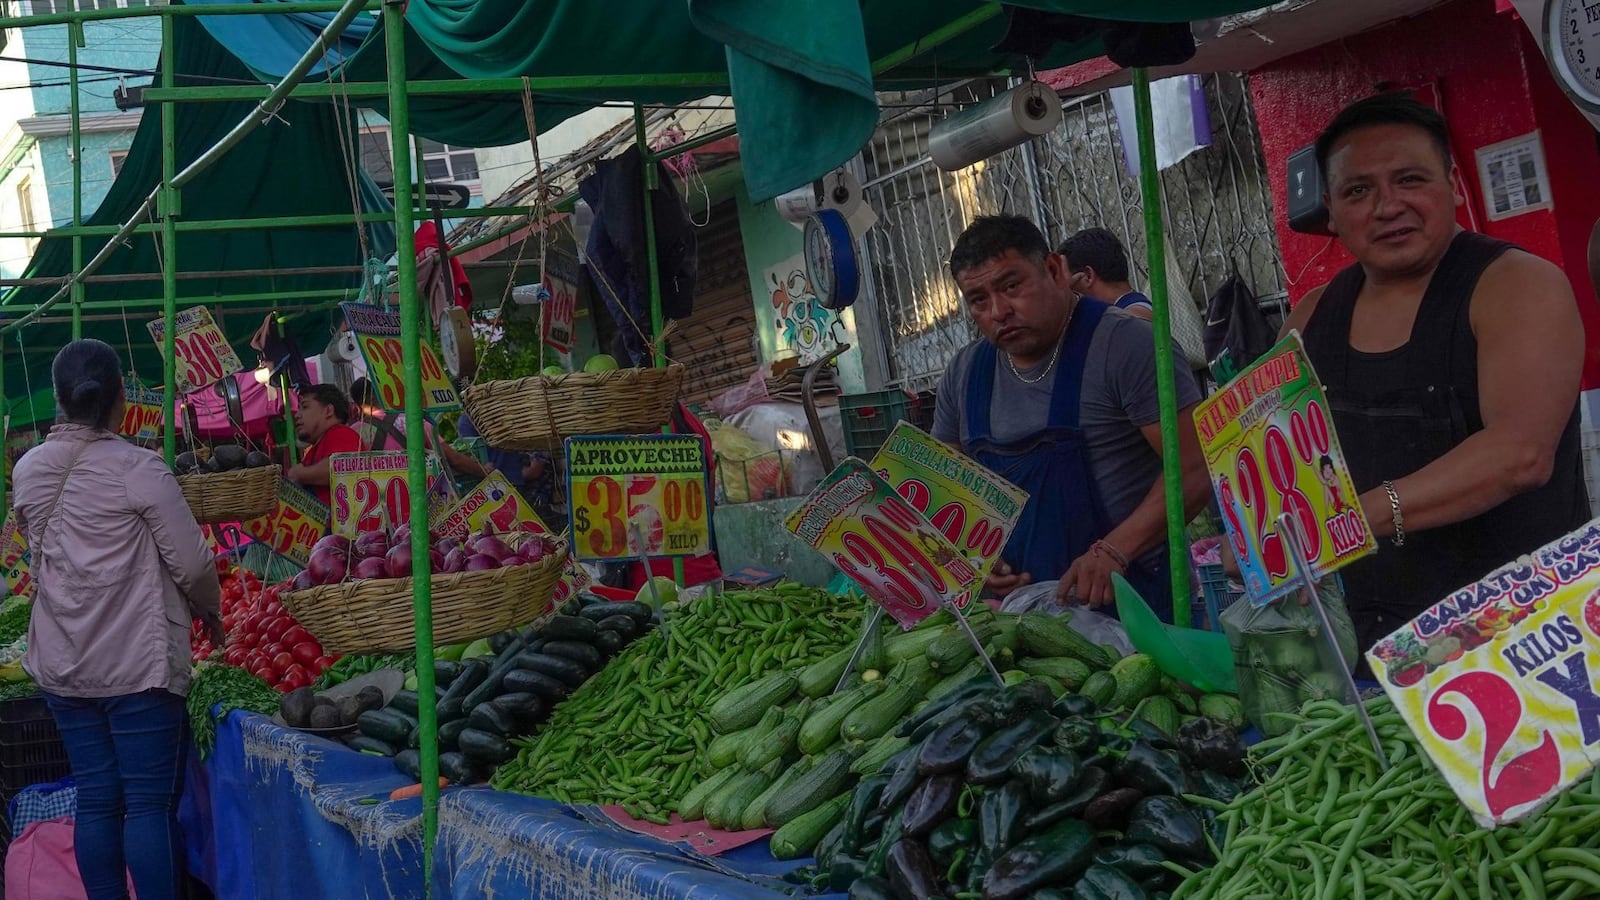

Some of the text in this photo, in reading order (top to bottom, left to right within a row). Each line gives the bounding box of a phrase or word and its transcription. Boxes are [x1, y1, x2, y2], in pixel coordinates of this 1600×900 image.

[1570, 19, 1579, 34] 2
[1585, 2, 1600, 23] FE
[1577, 49, 1585, 64] 3
[431, 389, 454, 404] KILO
[1199, 415, 1216, 445] SI
[1221, 389, 1240, 422] NO
[1236, 376, 1254, 408] TE
[1251, 351, 1300, 397] CUMPLE
[573, 447, 697, 465] APROVECHE
[887, 435, 1018, 520] LOS CHALANES NO SE VENDEN
[438, 489, 486, 535] CABRON
[1326, 508, 1367, 556] KILO
[669, 534, 698, 549] KILO
[1514, 542, 1600, 604] UN RAT
[1417, 565, 1533, 635] BARATO
[1502, 615, 1583, 677] KILOS
[1428, 671, 1561, 816] 2
